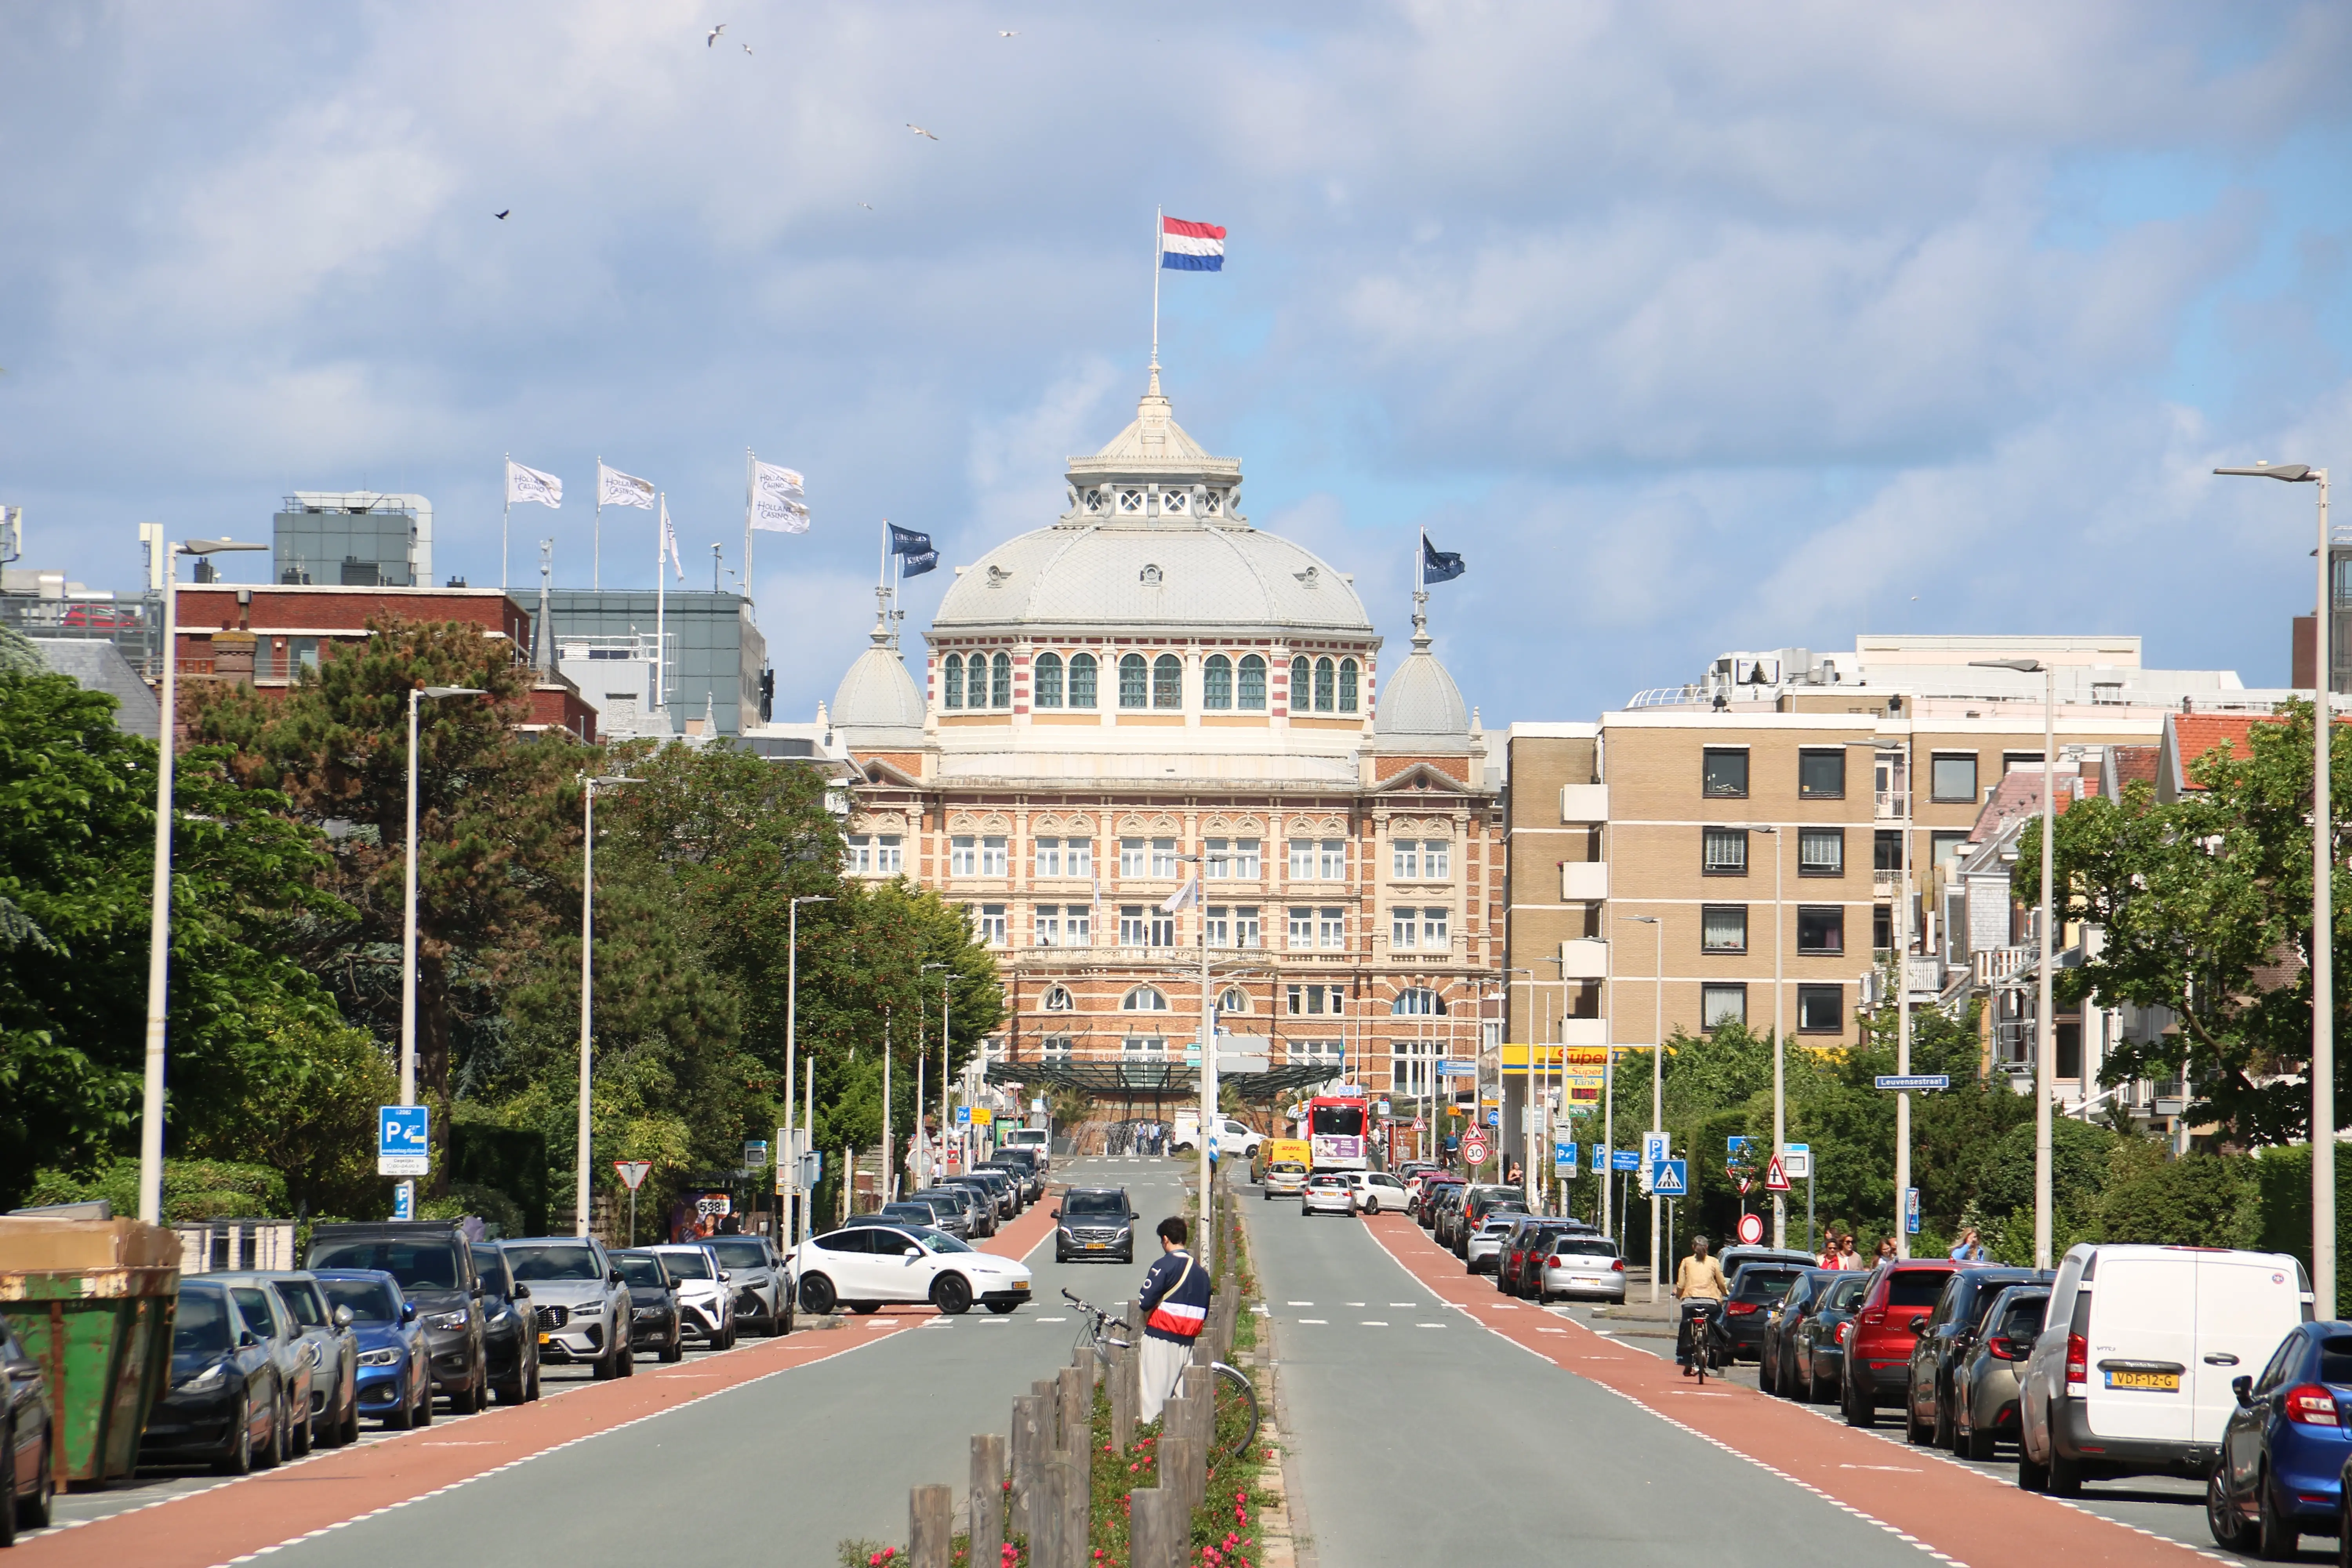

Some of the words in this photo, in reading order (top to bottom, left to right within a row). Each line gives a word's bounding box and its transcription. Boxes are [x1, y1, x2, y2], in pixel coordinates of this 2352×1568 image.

[514, 474, 545, 486] HOLLAN
[518, 483, 545, 492] CASINO
[609, 486, 634, 495] CASINO
[761, 510, 789, 520] CASINO
[1568, 1067, 1602, 1078] Super
[387, 1122, 401, 1142] P
[1652, 1141, 1661, 1152] P
[1468, 1149, 1482, 1157] 30
[1558, 1149, 1564, 1159] P
[1596, 1146, 1605, 1159] P
[398, 1188, 408, 1201] P
[700, 1202, 720, 1212] 538
[2117, 1372, 2172, 1386] VDF-12-G
